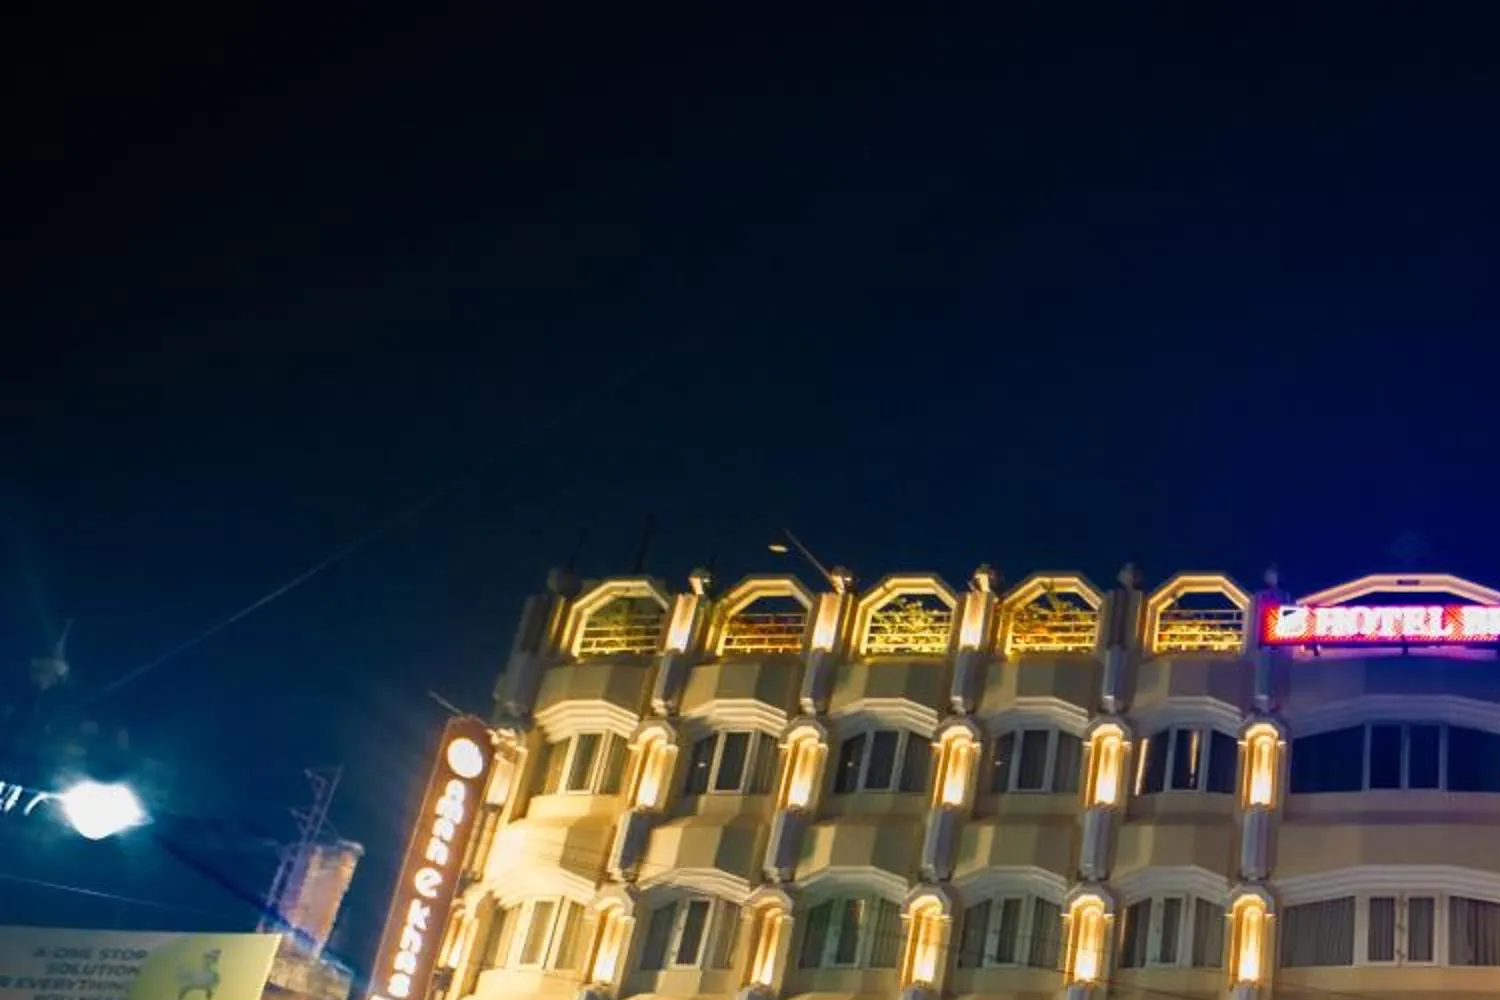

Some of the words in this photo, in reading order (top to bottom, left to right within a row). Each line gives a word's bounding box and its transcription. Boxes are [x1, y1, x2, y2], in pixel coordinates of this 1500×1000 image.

[1314, 606, 1453, 637] HOTEL
[98, 947, 149, 960] STOP
[46, 961, 141, 977] SOLUTION
